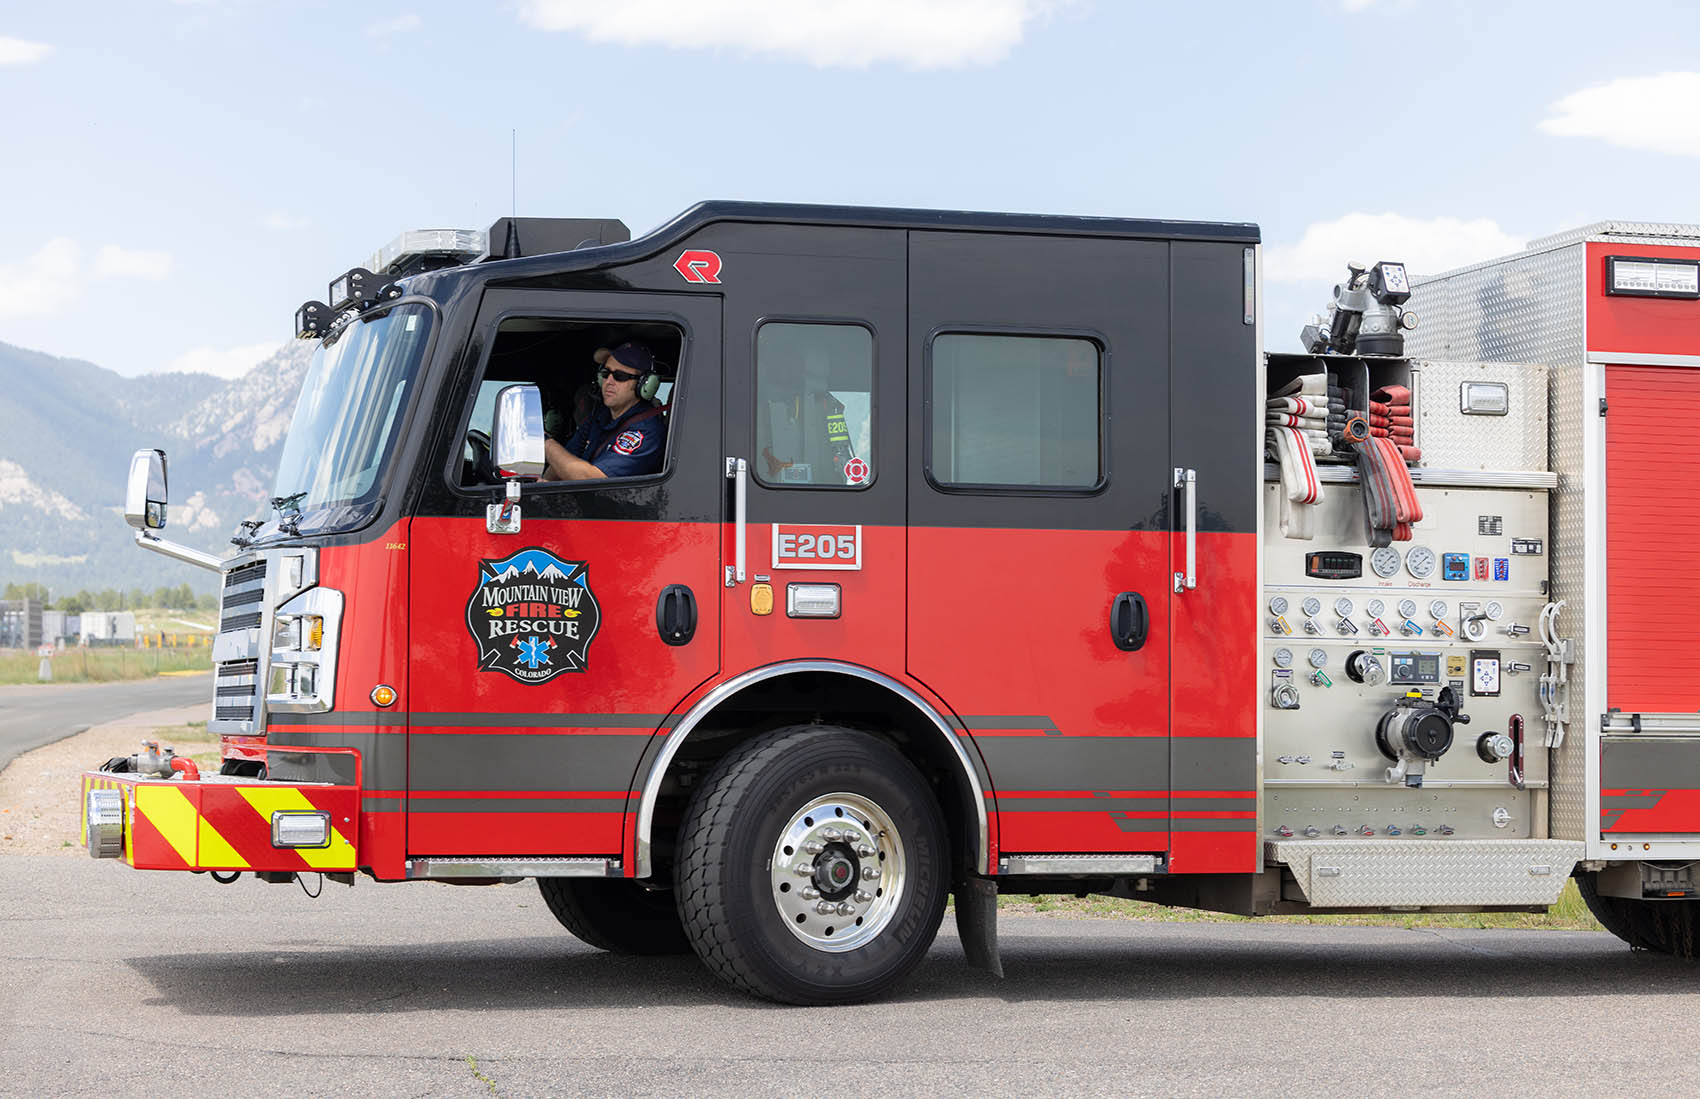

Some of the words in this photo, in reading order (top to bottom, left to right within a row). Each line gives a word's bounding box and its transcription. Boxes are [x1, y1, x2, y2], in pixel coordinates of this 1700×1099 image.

[778, 534, 855, 559] E205
[482, 585, 548, 607] MOUNTAIN
[550, 587, 584, 609] VIEW
[505, 603, 562, 618] FIRE
[488, 620, 580, 640] RESCUE
[514, 667, 552, 679] COLORADO
[898, 836, 930, 944] MICHELIN
